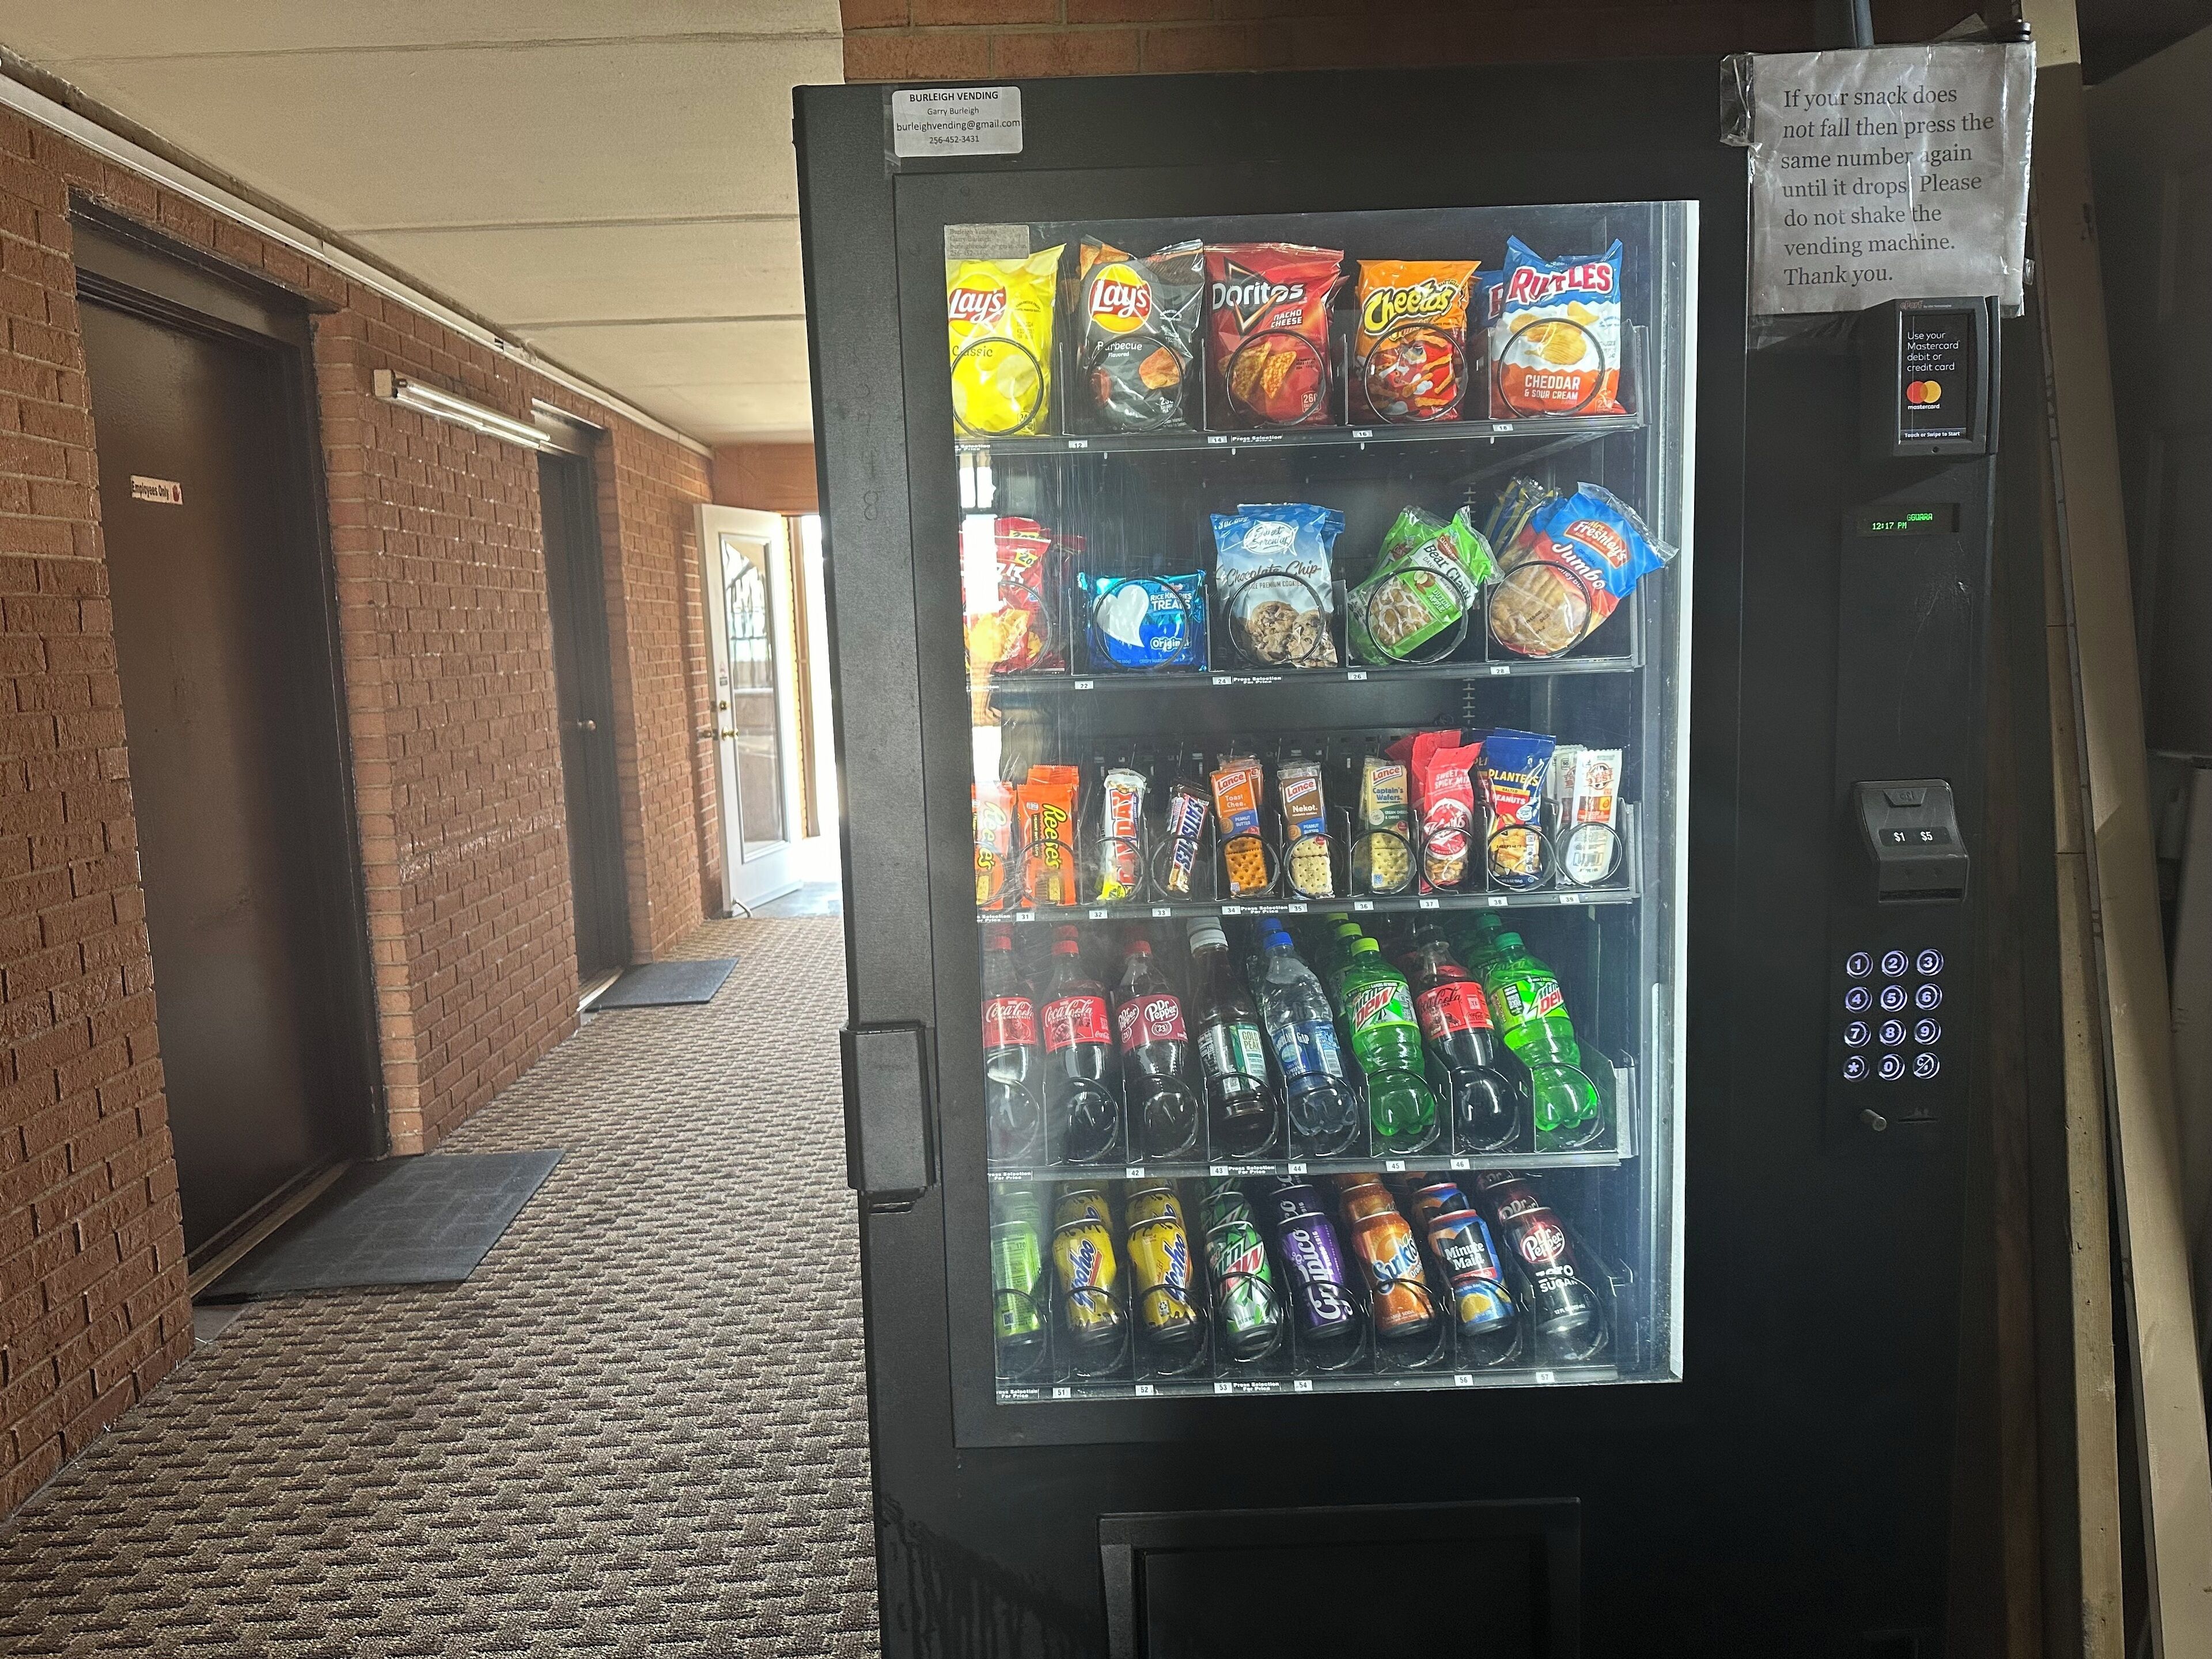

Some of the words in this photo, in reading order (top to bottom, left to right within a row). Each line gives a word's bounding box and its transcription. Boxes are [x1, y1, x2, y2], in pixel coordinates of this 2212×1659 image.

[910, 93, 955, 102] BURLEIGH
[958, 91, 998, 100] VENDING
[1784, 89, 1801, 108] If
[1804, 93, 1848, 111] your
[1854, 86, 1908, 104] snack
[1913, 85, 1957, 104] does
[950, 107, 979, 115] Burleigh
[896, 119, 1020, 132] burleighvending@gmail.com
[1783, 122, 1815, 138] not
[1820, 118, 1850, 137] fall
[1856, 118, 1898, 136] then
[1904, 118, 1956, 139] press
[1961, 113, 1994, 131] the
[929, 135, 979, 145] 256-452-3431
[1781, 155, 1831, 169] same
[1836, 148, 1914, 166] number
[1920, 146, 1972, 166] again
[1782, 179, 1828, 197] until
[1833, 178, 1847, 195] it
[1920, 174, 1982, 192] Please
[1784, 209, 1808, 226] do
[1814, 210, 1847, 225] not
[1851, 204, 1906, 224] shake
[1912, 204, 1942, 221] the
[1785, 237, 1863, 256] vending
[1868, 233, 1956, 252] machine.
[1785, 266, 1848, 286] Thank
[1850, 268, 1893, 287] you.
[1092, 280, 1147, 318] Lay's
[1213, 281, 1304, 310] Doritos
[949, 289, 1004, 324] Lay's
[1271, 317, 1302, 328] CHEESE
[1274, 309, 1302, 321] NACHO
[1926, 333, 1946, 341] your
[1907, 342, 1959, 350] Mastercard
[1935, 362, 1955, 370] card
[1525, 376, 1581, 390] CHEDDAR
[1532, 390, 1550, 399] SOUR
[1552, 391, 1578, 400] CREAM
[132, 480, 158, 498] Employees
[158, 484, 169, 501] Only
[1574, 521, 1627, 561] Freshley's
[1227, 564, 1282, 587] Chocolate
[1286, 560, 1321, 578] Chip
[1423, 544, 1449, 568] Bear
[1446, 567, 1472, 599] Claw
[1552, 544, 1605, 589] Jumbo
[1152, 600, 1191, 611] TREAS
[1427, 594, 1446, 613] APPLE
[1433, 589, 1451, 608] DUTCH
[1218, 774, 1244, 791] Lance
[1373, 768, 1400, 781] Lance
[1435, 769, 1459, 781] SWEET
[1488, 768, 1540, 786] PLANTES
[1287, 781, 1315, 797] Lance
[1894, 832, 1906, 842] $1
[1921, 831, 1933, 841] $5
[1855, 959, 1861, 969] 1
[1888, 958, 1897, 968] 2
[1924, 957, 1933, 968] 3
[1156, 999, 1169, 1010] Dr
[1852, 994, 1861, 1004] 4
[1887, 993, 1896, 1003] 5
[1922, 991, 1931, 1002] 6
[1145, 1003, 1176, 1022] Pepper
[1242, 1031, 1258, 1041] GOLD
[1851, 1028, 1859, 1039] 7
[1885, 1028, 1895, 1037] 8
[1921, 1027, 1929, 1036] 9
[1244, 1041, 1260, 1049] PEAK
[1884, 1061, 1893, 1071] 0
[1445, 1243, 1484, 1260] Minute
[1453, 1253, 1484, 1270] Maid
